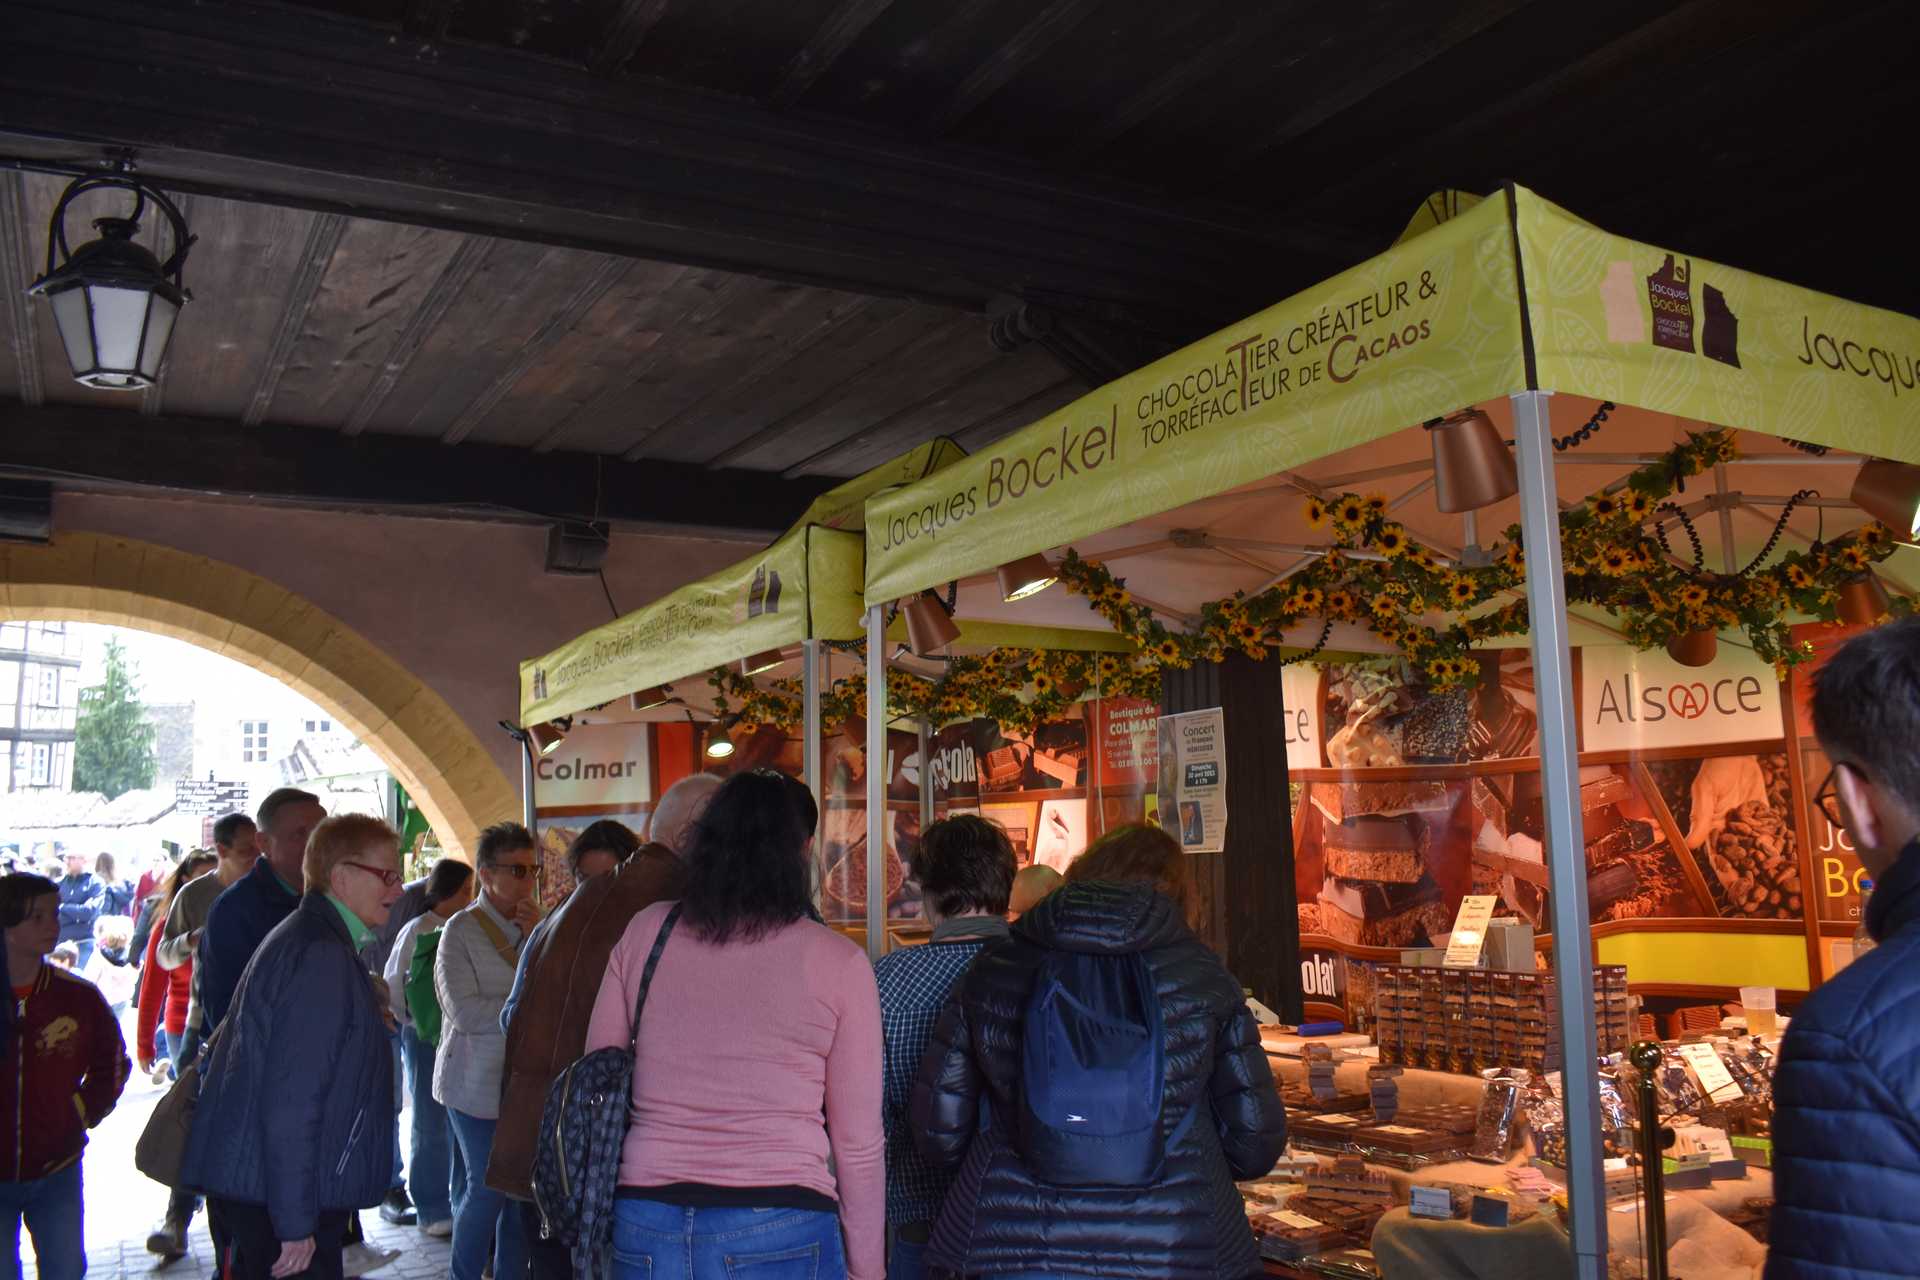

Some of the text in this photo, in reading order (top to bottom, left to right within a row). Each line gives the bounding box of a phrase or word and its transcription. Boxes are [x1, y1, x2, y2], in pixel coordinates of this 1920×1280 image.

[1650, 281, 1690, 300] Jacques
[1651, 294, 1691, 316] Bockel
[1137, 269, 1438, 420] CHOCOLATIER CRÉATEUR &
[1798, 315, 1920, 398] Jacqu
[1141, 365, 1291, 450] TORRÉFACTEUR
[883, 404, 1119, 553] Jacques Bockel
[1596, 673, 1762, 725] Alsace
[1109, 718, 1157, 736] COLMAR
[1183, 725, 1215, 736] Concert
[537, 758, 637, 780] Colmar
